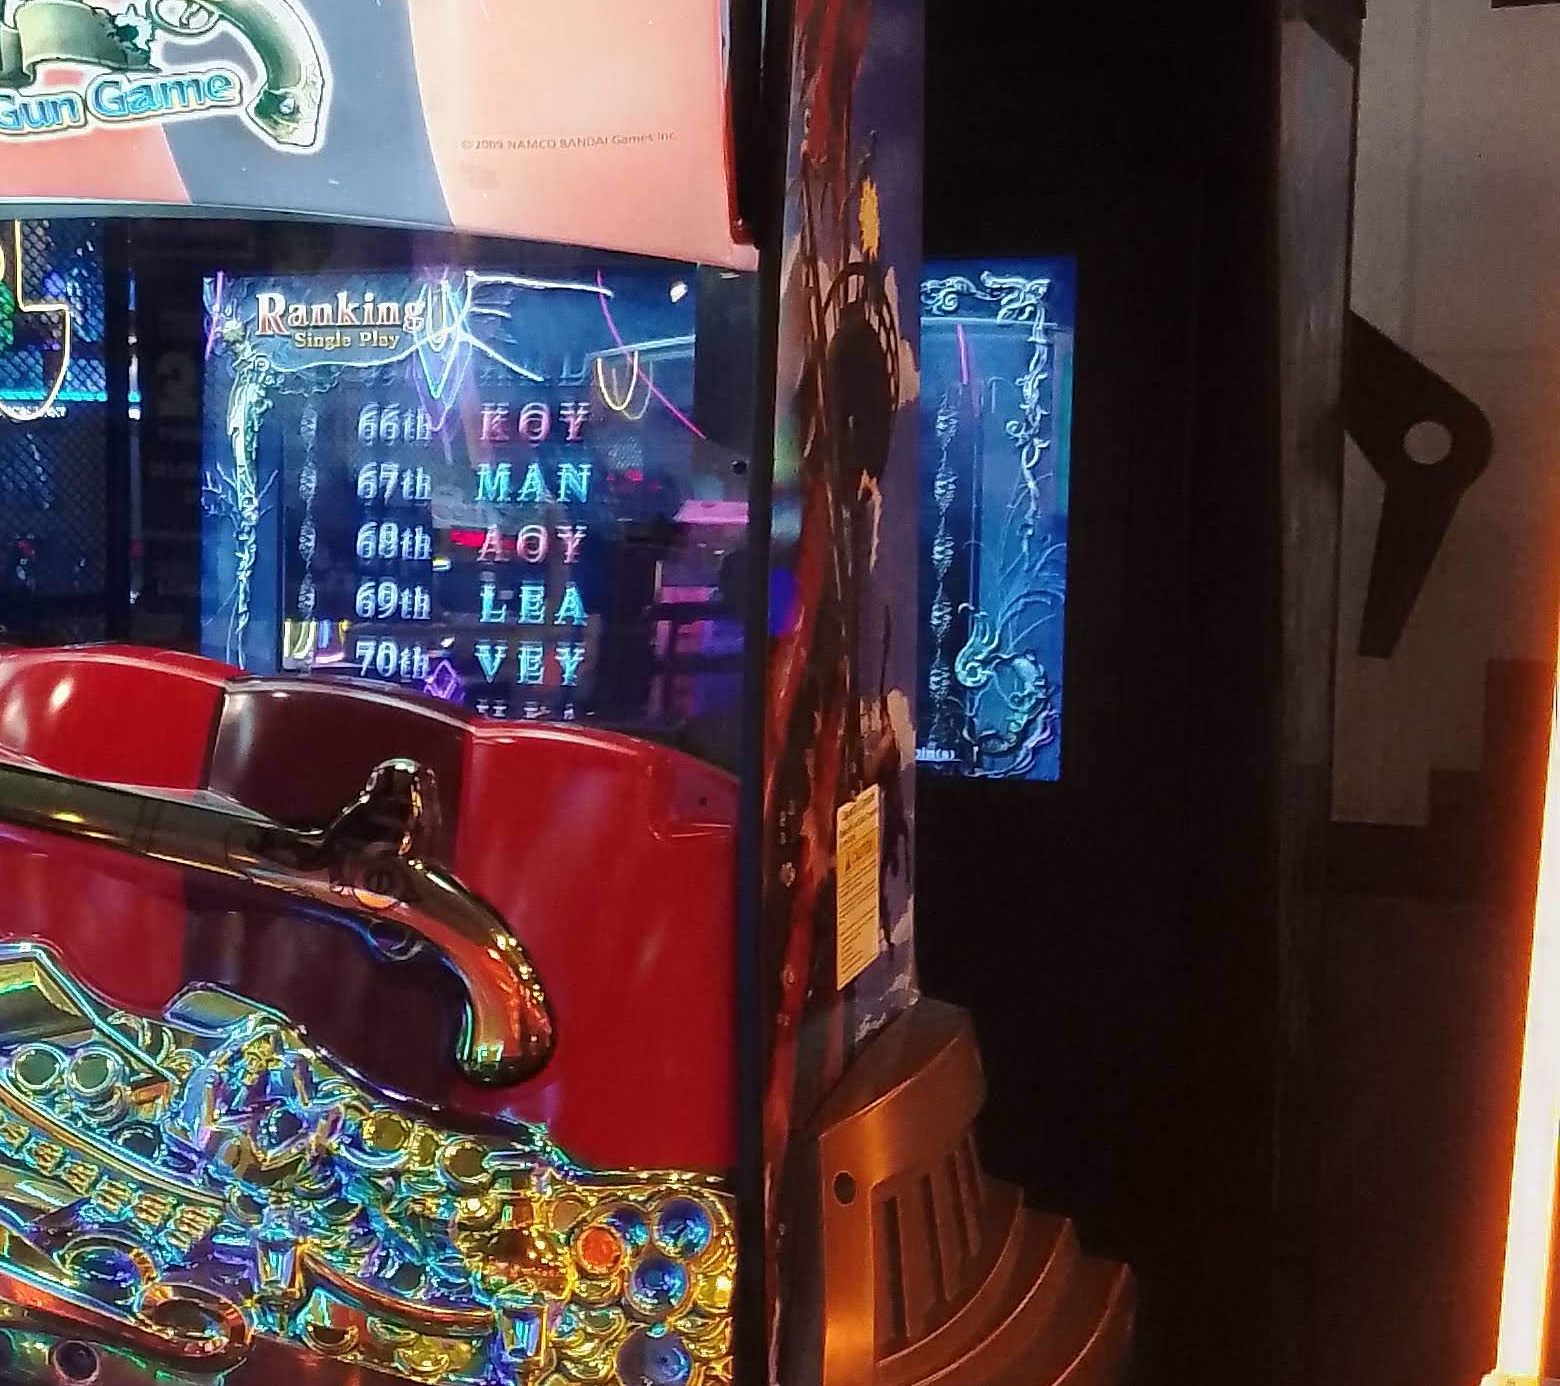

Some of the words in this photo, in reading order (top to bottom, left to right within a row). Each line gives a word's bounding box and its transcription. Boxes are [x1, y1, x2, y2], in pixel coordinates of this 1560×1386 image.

[90, 71, 236, 116] Game
[507, 139, 557, 150] NAMCO
[559, 136, 609, 149] BANDAI
[611, 134, 654, 145] Games
[255, 291, 428, 336] Ranking
[294, 331, 352, 350] Single
[359, 332, 401, 350] Play
[356, 402, 433, 444] 66th
[356, 462, 432, 504] 67th
[475, 462, 592, 503] MAN
[355, 581, 431, 621] 69th
[479, 580, 589, 627] LEA
[355, 638, 430, 681] 70th
[474, 640, 587, 686] VEY
